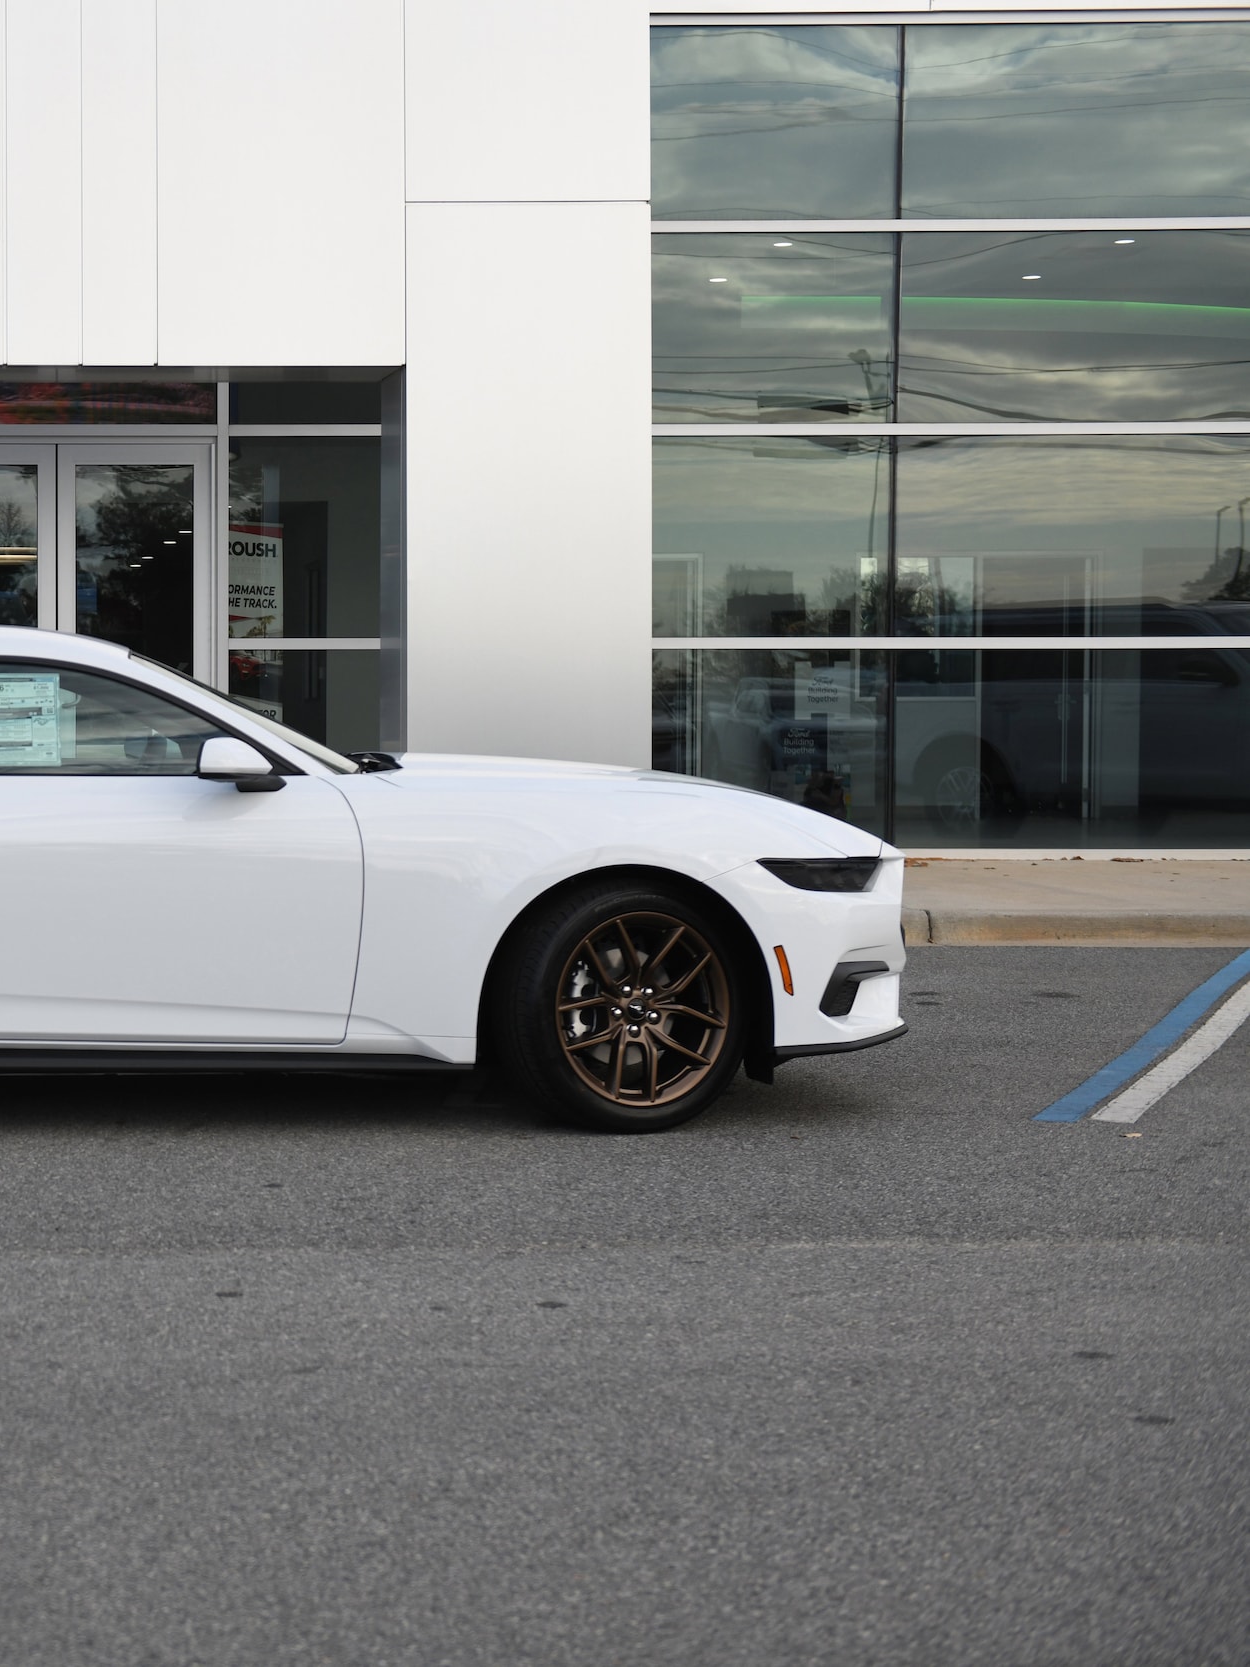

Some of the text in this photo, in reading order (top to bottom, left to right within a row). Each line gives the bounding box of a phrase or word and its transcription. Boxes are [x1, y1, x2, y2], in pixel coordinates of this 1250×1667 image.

[229, 584, 276, 596] ORMANCE
[243, 598, 277, 609] TRACK.
[808, 687, 838, 695] Building
[807, 695, 838, 703] Together
[783, 738, 815, 746] Building
[783, 747, 815, 755] Together
